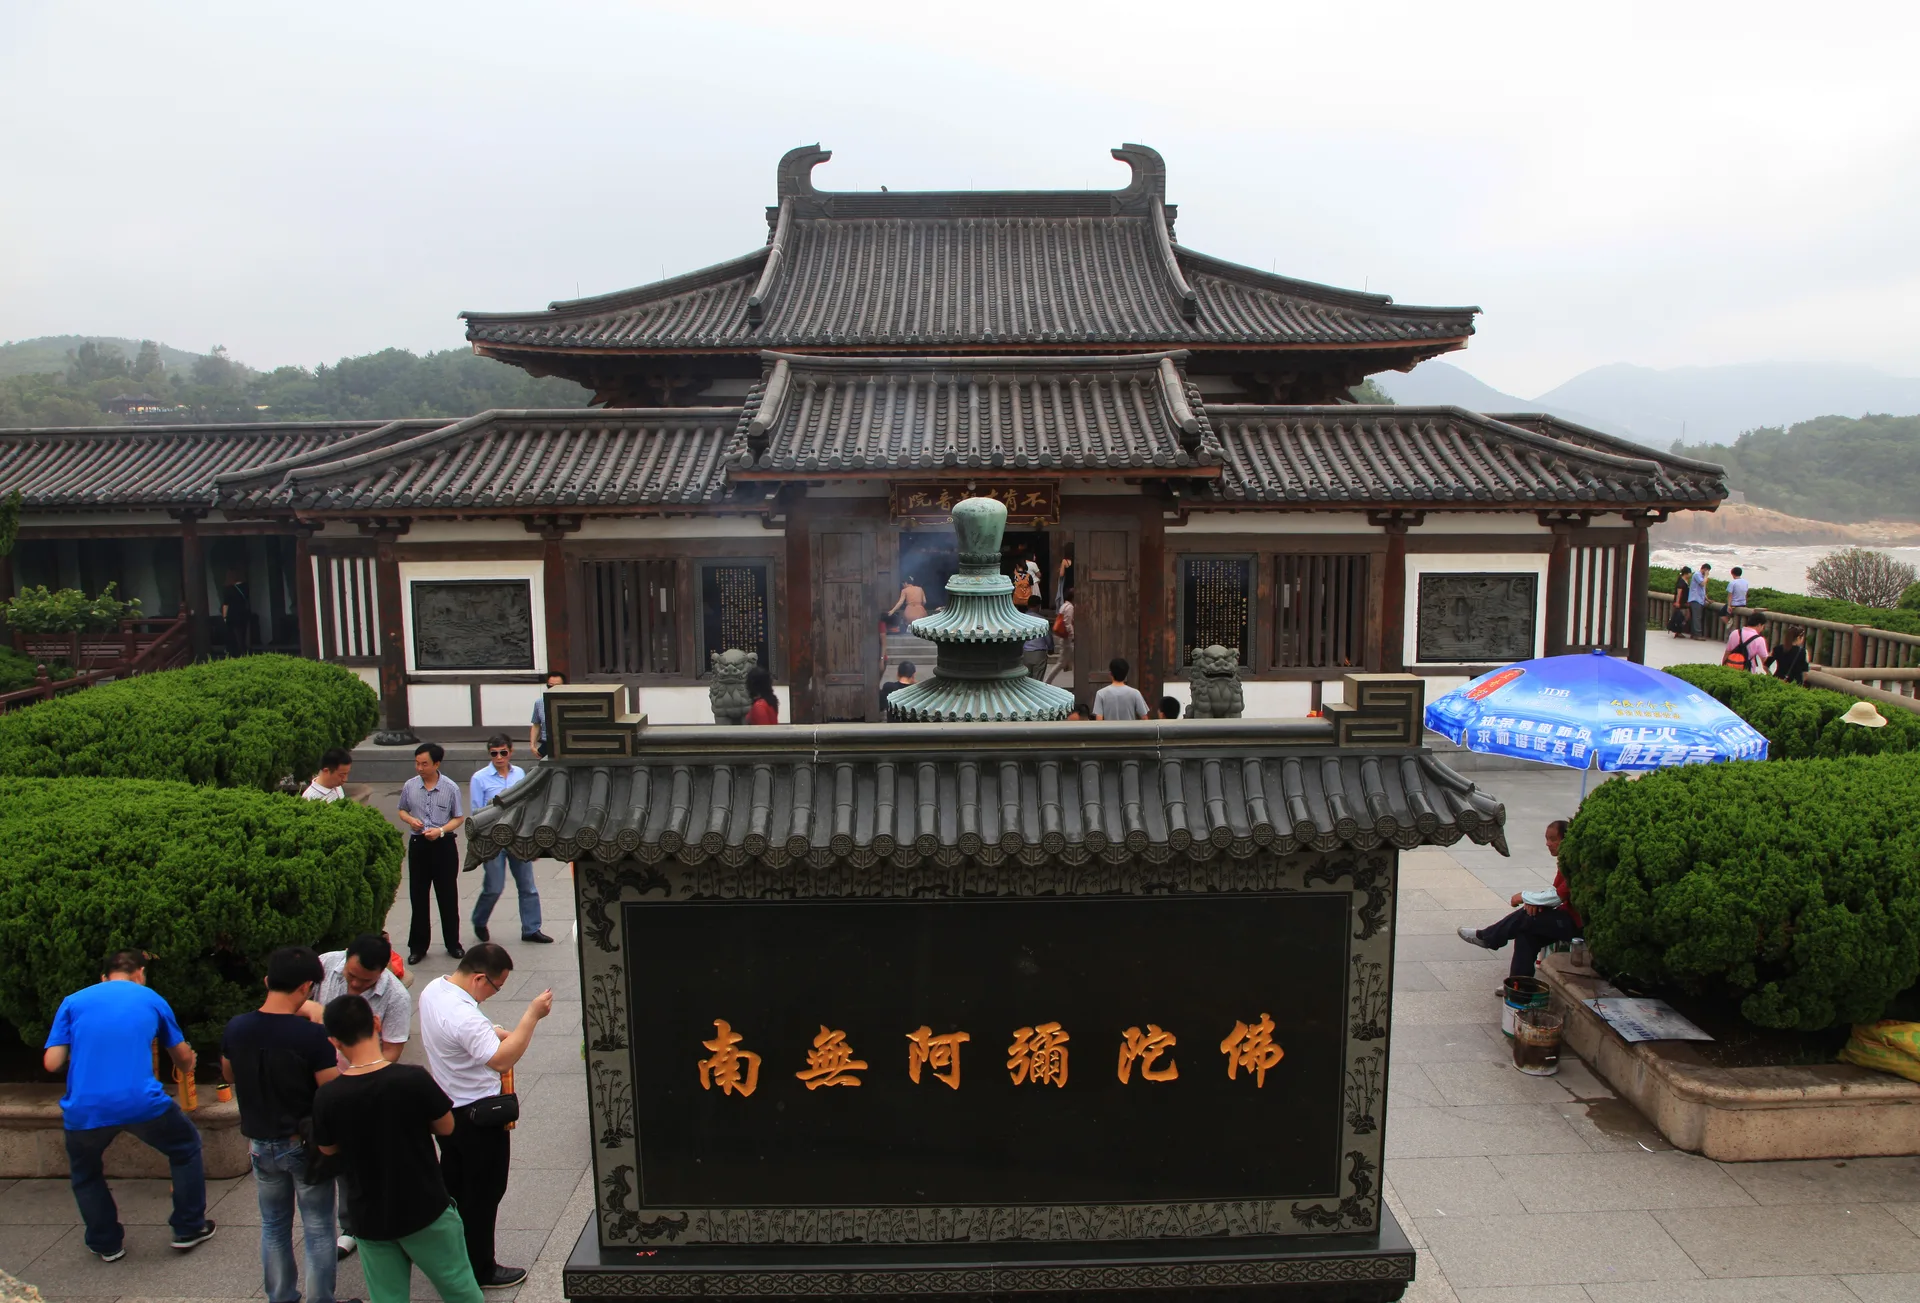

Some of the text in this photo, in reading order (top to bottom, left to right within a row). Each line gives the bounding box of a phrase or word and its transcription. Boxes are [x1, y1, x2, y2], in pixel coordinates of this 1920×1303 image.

[1538, 687, 1571, 698] JDB
[1479, 715, 1592, 742] 知荣辱树新风
[1610, 727, 1679, 744] 怕上火
[1477, 729, 1587, 759] 求和谐促发展
[1616, 743, 1716, 766] 喝王老吉
[698, 1012, 1285, 1098] 南無阿彌陀佛
